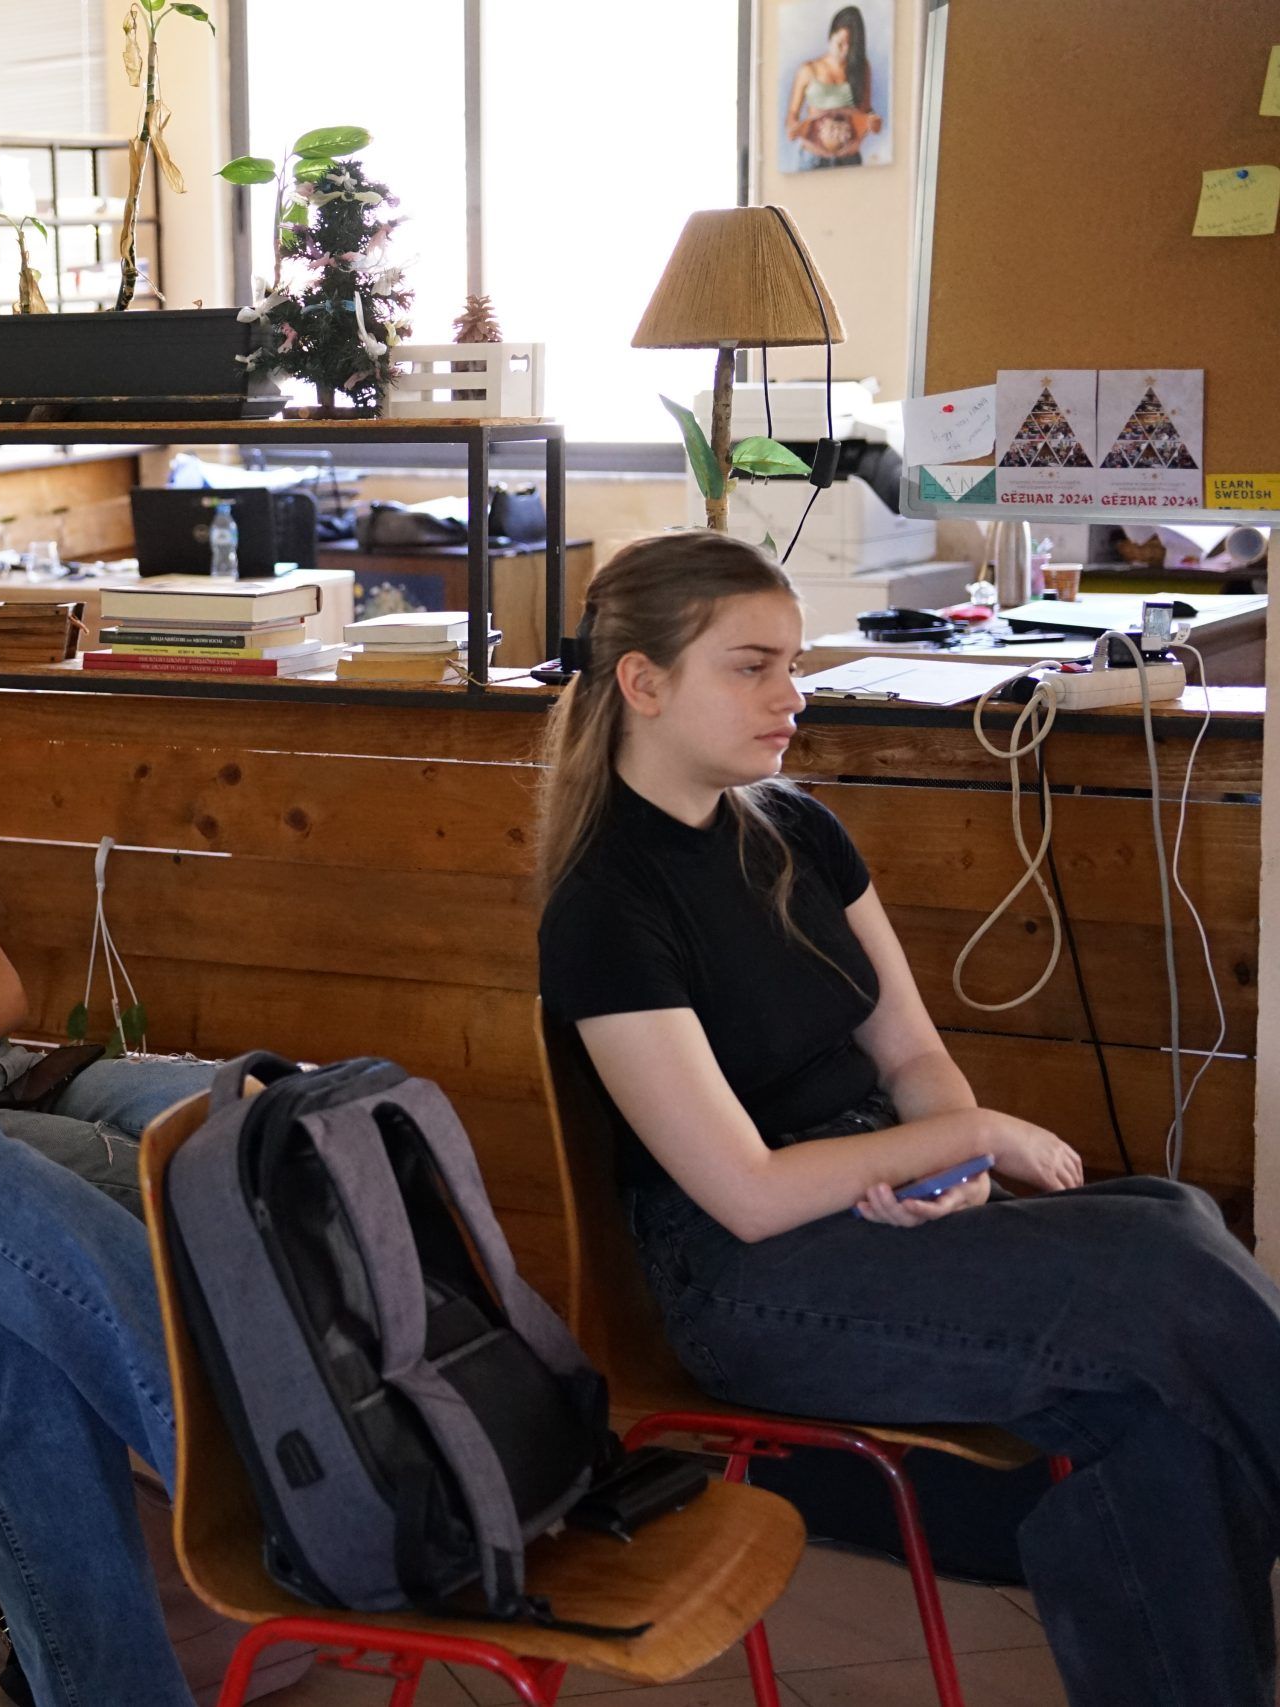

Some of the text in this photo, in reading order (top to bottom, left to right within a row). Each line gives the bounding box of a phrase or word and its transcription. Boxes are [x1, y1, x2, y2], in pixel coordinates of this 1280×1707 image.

[1214, 479, 1254, 489] LEARN
[1000, 491, 1094, 505] GËZUAR 2024!
[1101, 493, 1200, 508] GËZUAR 2024!
[1215, 490, 1272, 500] SWEDISH
